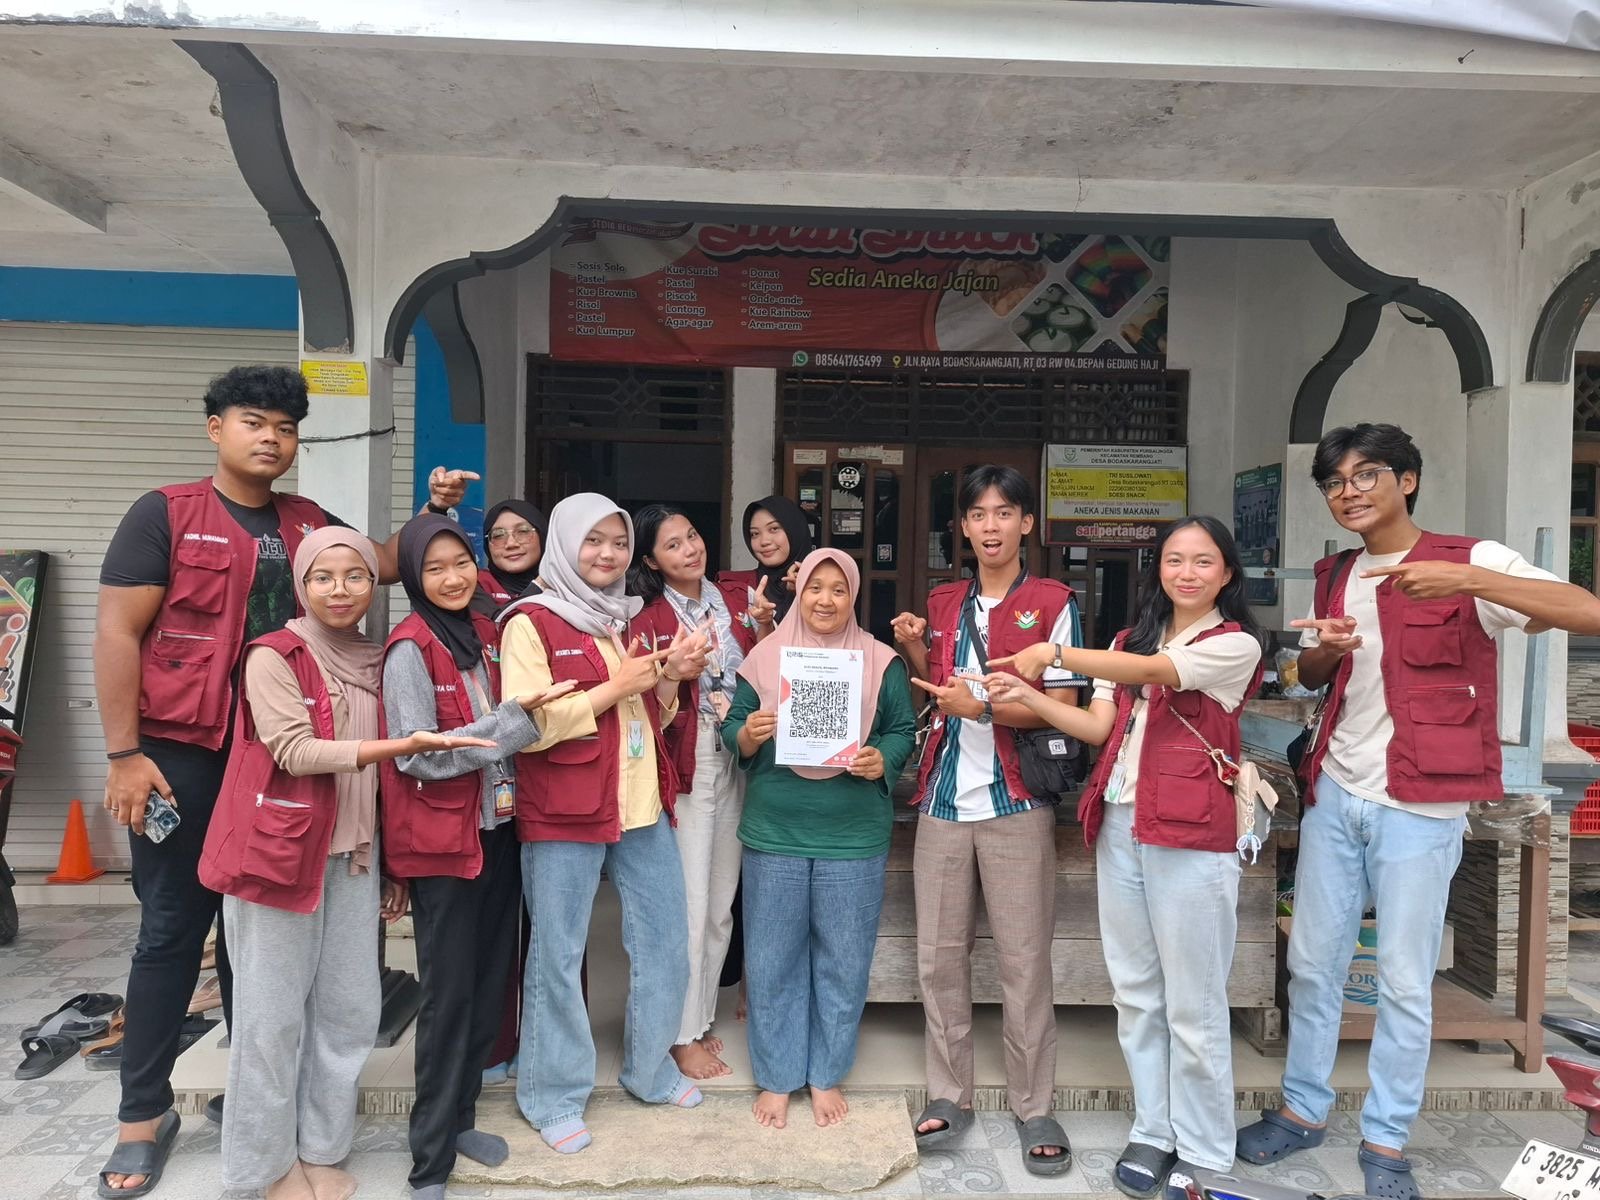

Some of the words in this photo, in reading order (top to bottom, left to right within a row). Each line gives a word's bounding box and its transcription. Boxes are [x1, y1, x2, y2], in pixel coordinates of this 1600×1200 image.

[576, 261, 600, 270] Sosis
[604, 262, 625, 272] Solo
[666, 265, 685, 274] Kue
[688, 266, 719, 276] Surabi
[750, 268, 780, 278] Donat
[576, 274, 606, 284] Pastel
[666, 278, 695, 288] Pastel
[808, 268, 866, 288] Sedia
[870, 268, 938, 290] Aneka
[942, 271, 999, 296] Jajan
[576, 287, 596, 296] Kue
[666, 291, 697, 301] Piscok
[576, 300, 601, 309] Risol
[749, 294, 804, 305] Onde-onde
[666, 304, 706, 316] Lontong
[749, 306, 768, 316] Kue
[770, 307, 811, 318] Rainbow
[576, 312, 606, 322] Pastel
[665, 317, 714, 329] Agar-agar
[748, 320, 802, 331] Arem-arem
[576, 326, 596, 335] Kue
[597, 326, 636, 338] Lumpur
[815, 353, 882, 367] 085641765499
[1024, 358, 1035, 369] RT
[1048, 358, 1063, 368] RW
[1106, 358, 1138, 370] GEDUNG
[1140, 360, 1159, 370] HAJI
[1101, 507, 1121, 515] JENIS
[1123, 507, 1160, 515] MAKANAN
[1540, 1151, 1584, 1181] 3825
